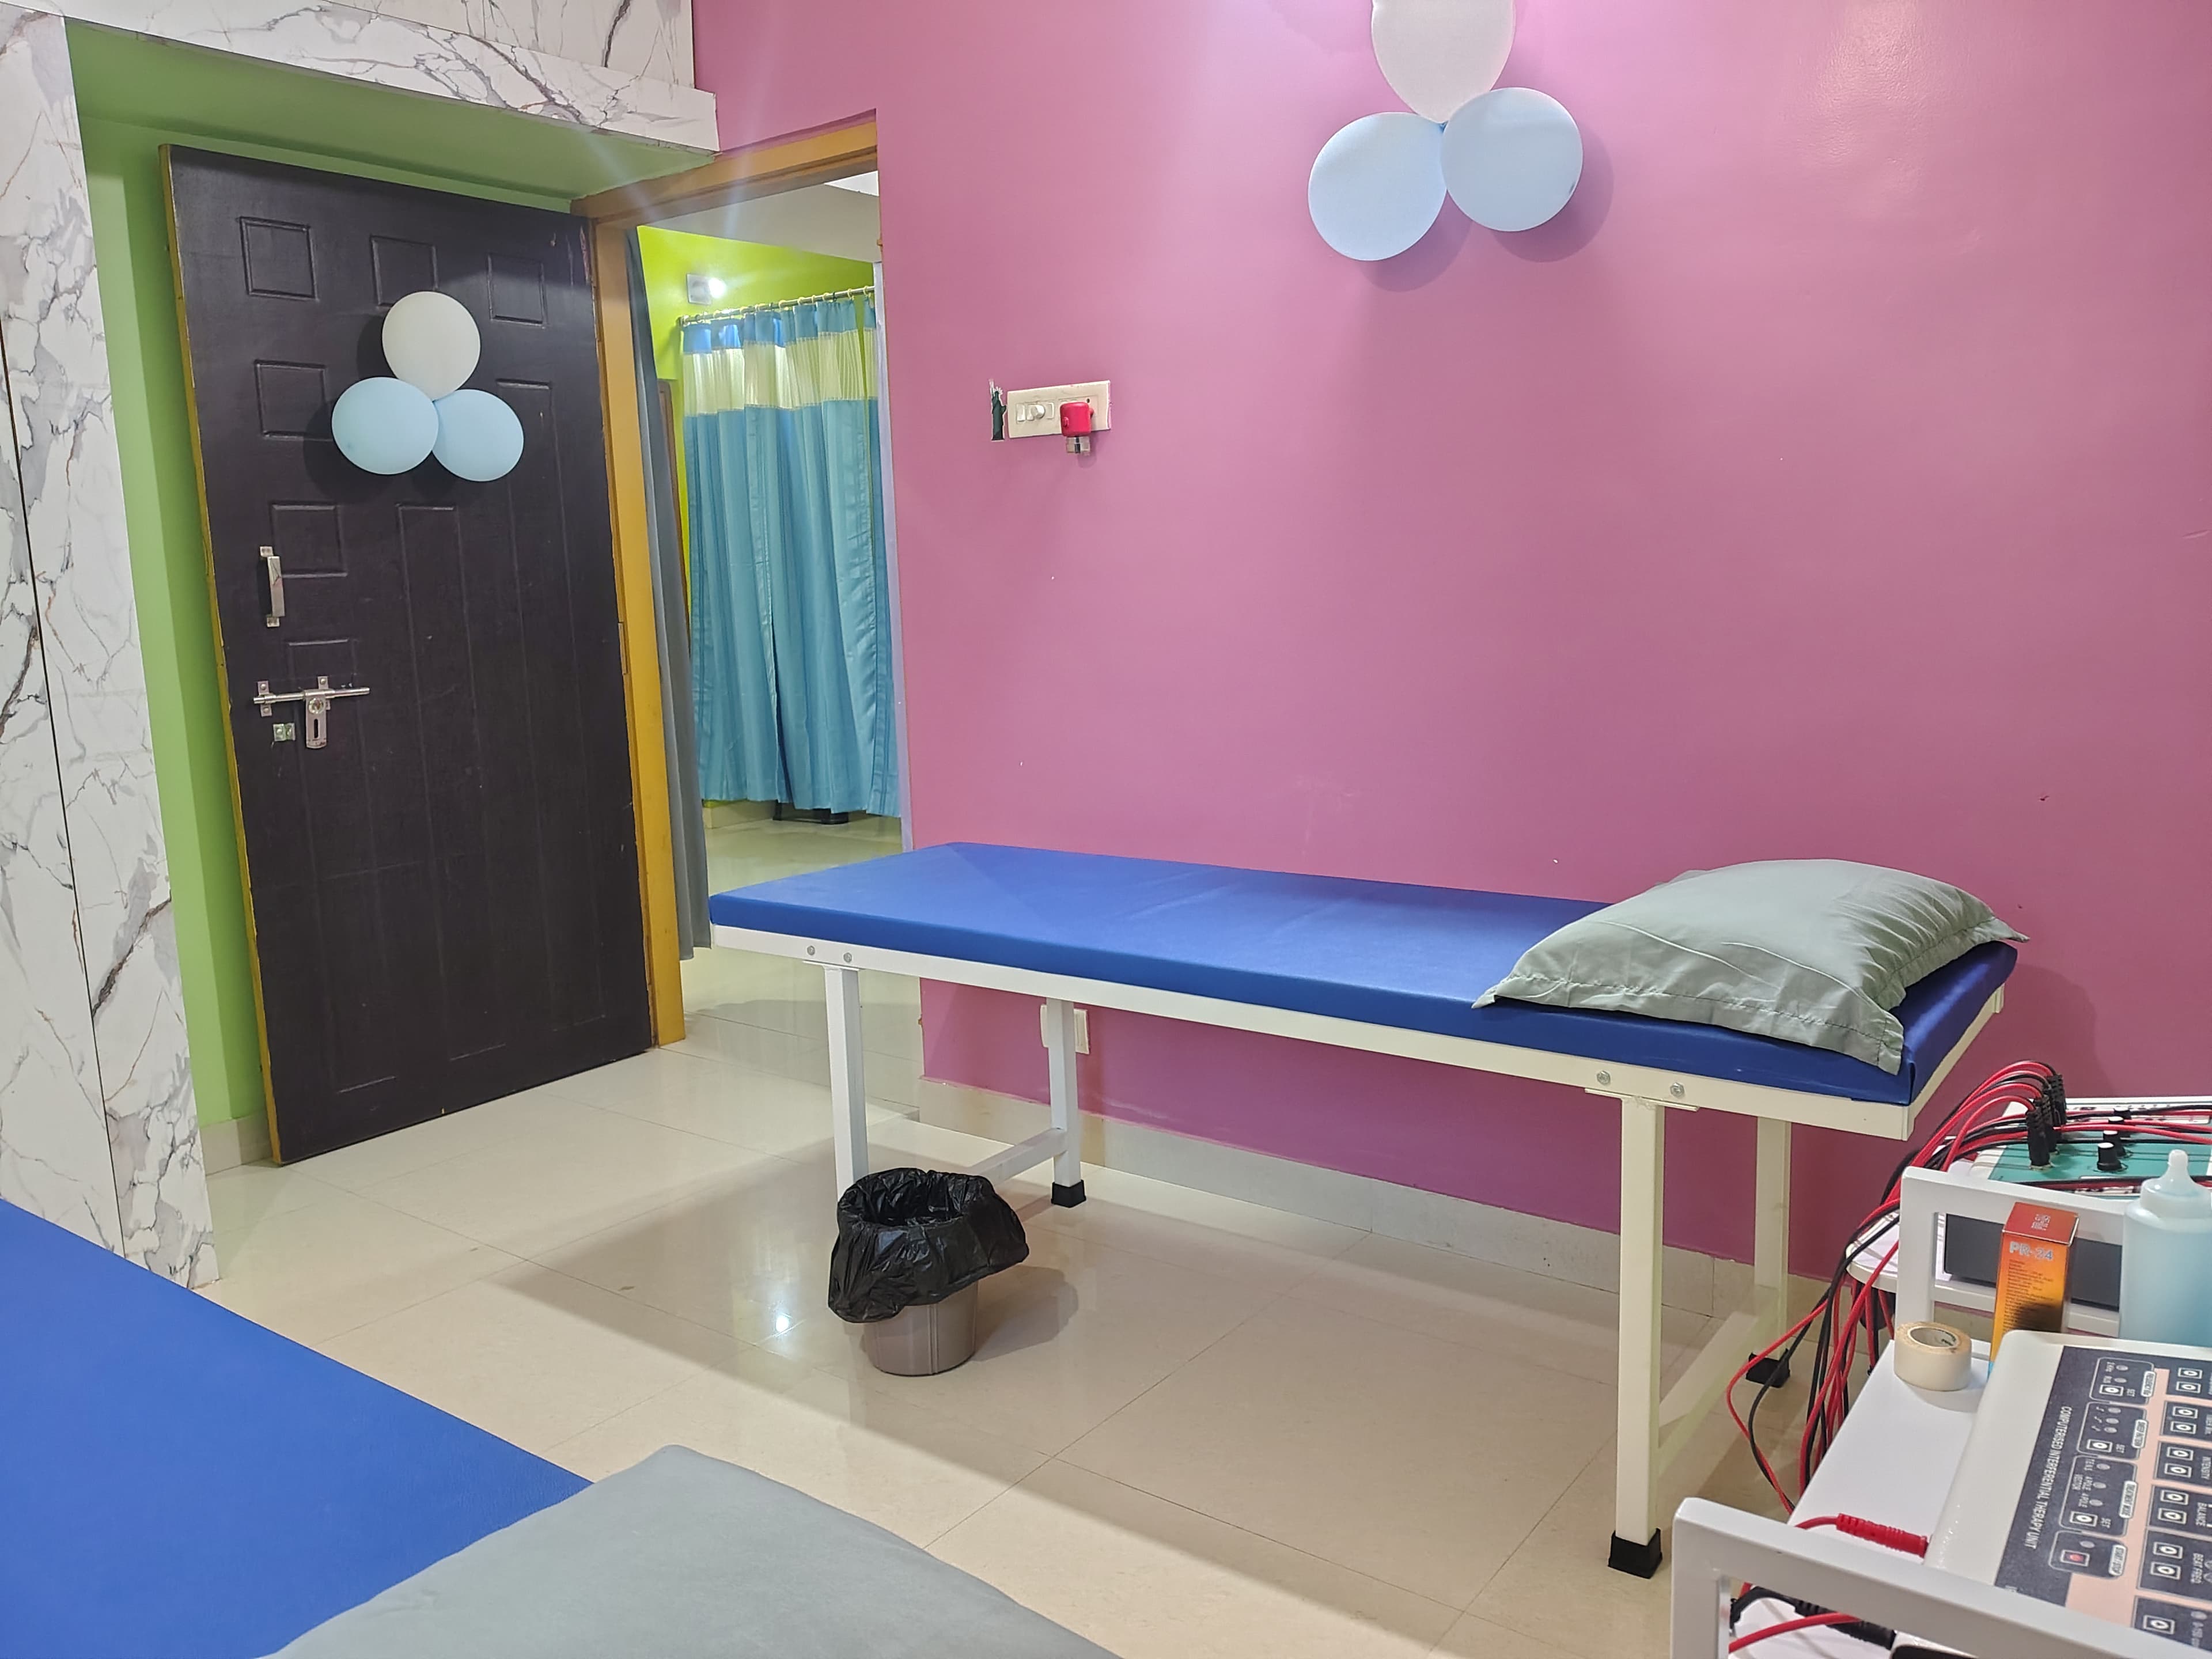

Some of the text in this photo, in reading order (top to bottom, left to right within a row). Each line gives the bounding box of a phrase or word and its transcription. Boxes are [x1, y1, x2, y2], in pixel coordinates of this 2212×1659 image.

[2009, 1241, 2053, 1260] PR-24
[2126, 1388, 2135, 1397] SET
[2116, 1444, 2125, 1453] SET
[2201, 1456, 2211, 1480] INTENSITY
[2024, 1406, 2072, 1550] COMPUTERISED INTERFERENTIAL THERAPY UNIT
[2100, 1517, 2111, 1528] SET
[2195, 1502, 2207, 1527] BALANCE
[2192, 1552, 2204, 1569] BEAT
